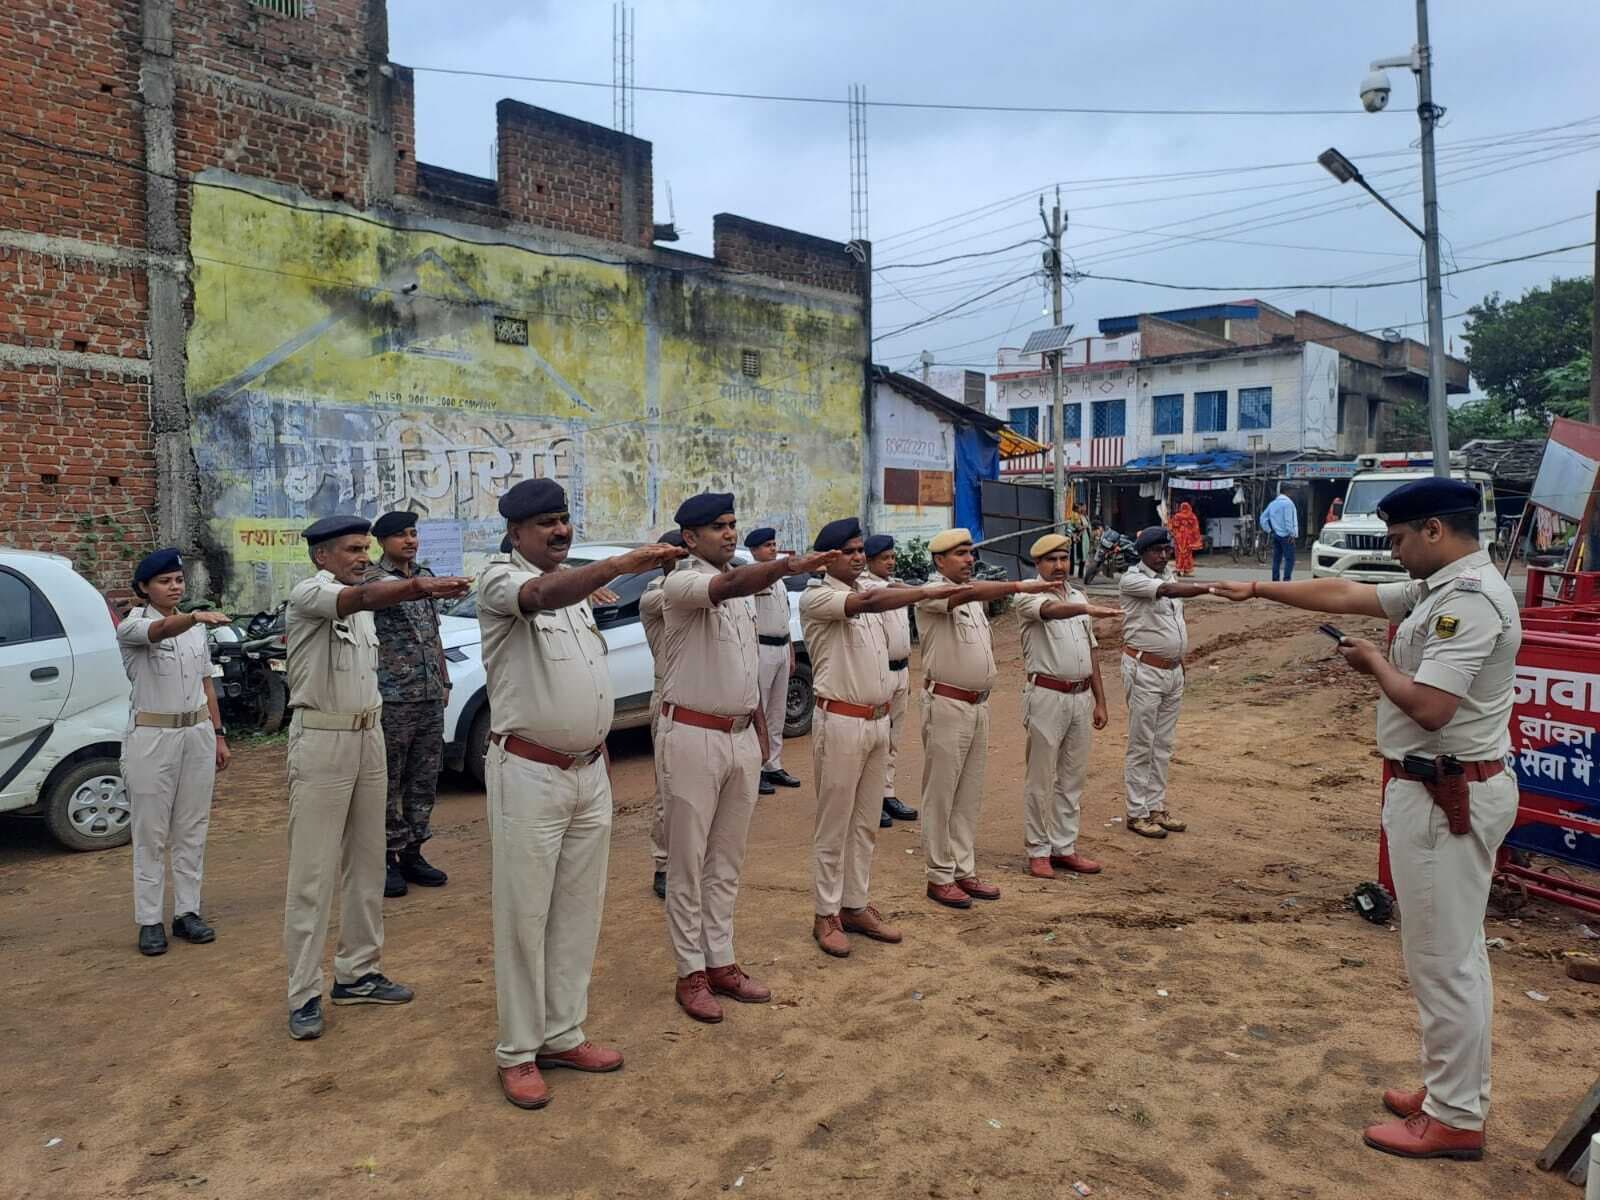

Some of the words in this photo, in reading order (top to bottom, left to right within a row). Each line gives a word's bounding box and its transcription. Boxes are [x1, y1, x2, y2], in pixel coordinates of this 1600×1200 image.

[1518, 711, 1596, 750] बांका
[1520, 739, 1567, 781] सेवा
[1570, 748, 1594, 786] में
